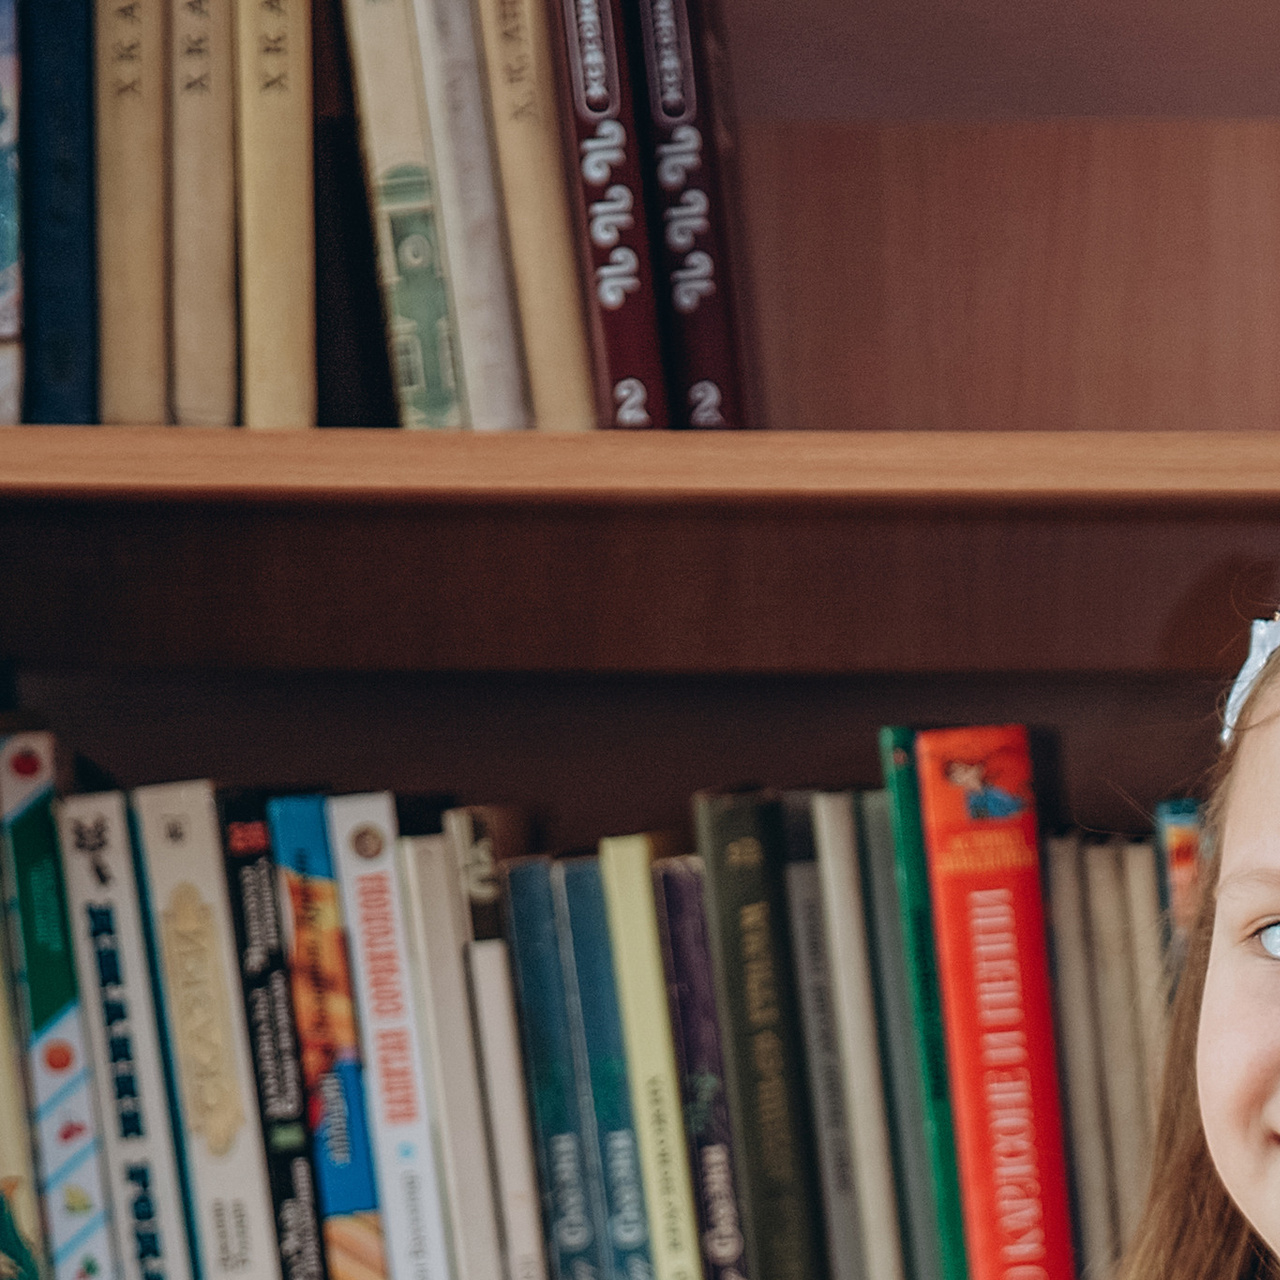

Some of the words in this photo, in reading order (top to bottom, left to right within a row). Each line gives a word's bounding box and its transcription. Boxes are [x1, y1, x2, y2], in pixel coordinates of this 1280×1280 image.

[613, 376, 652, 428] 2
[688, 378, 726, 429] 2
[981, 1030, 1027, 1067] И
